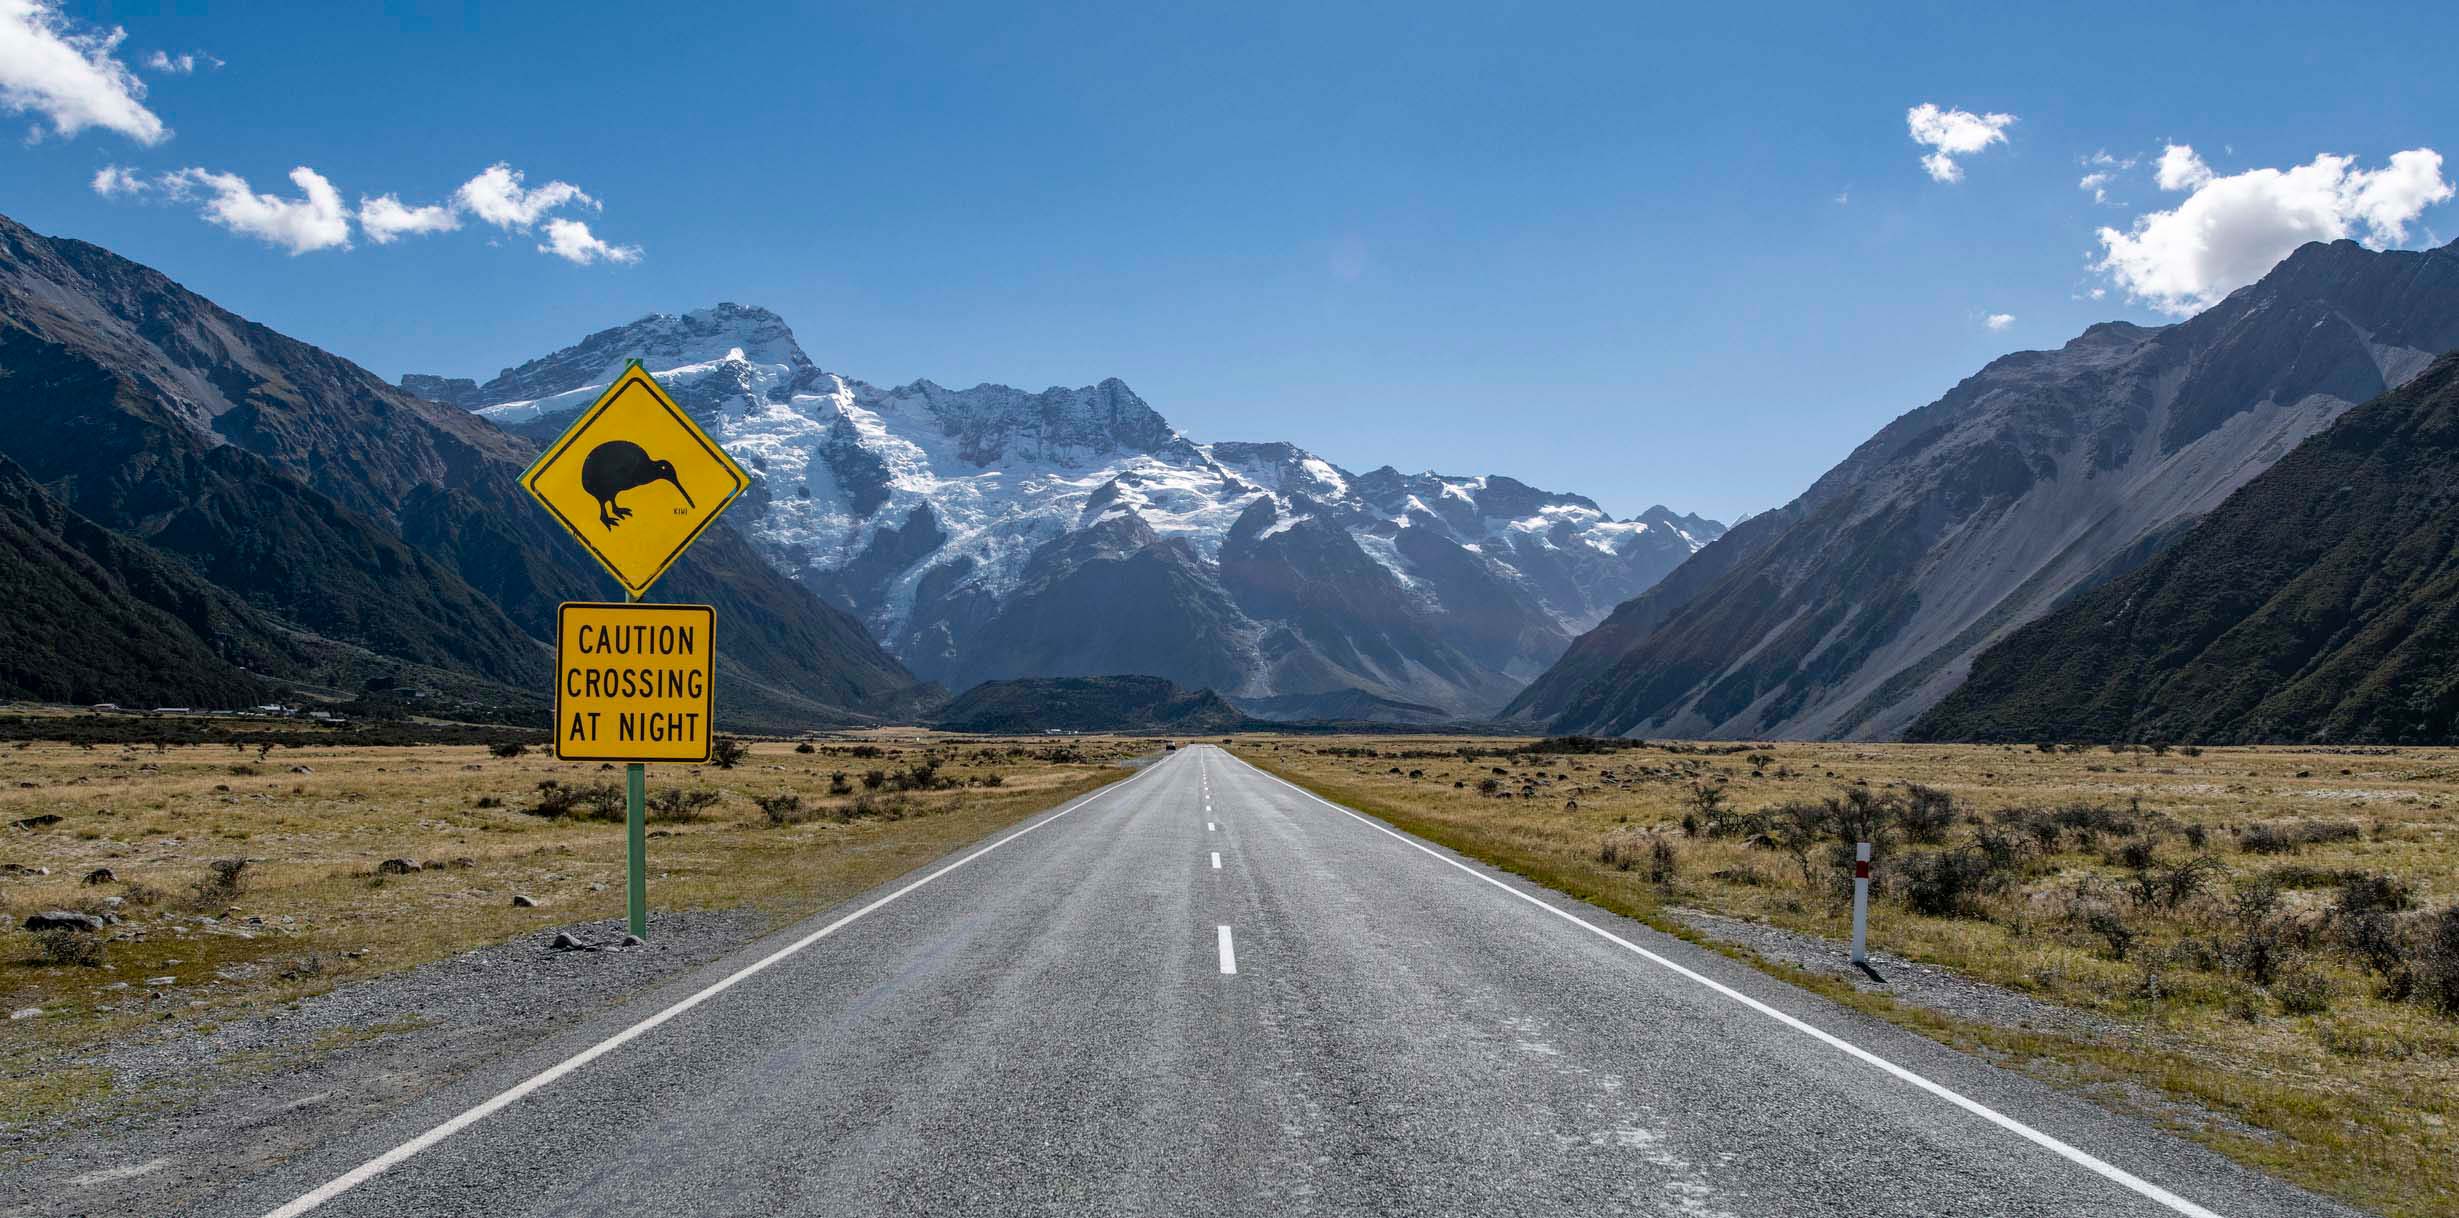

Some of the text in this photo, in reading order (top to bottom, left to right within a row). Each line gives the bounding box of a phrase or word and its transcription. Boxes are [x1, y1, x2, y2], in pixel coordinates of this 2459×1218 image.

[673, 507, 688, 515] KIWI
[578, 624, 694, 655] CAUTION
[567, 668, 703, 699] CROSSING
[569, 712, 699, 742] AT NIGHT
